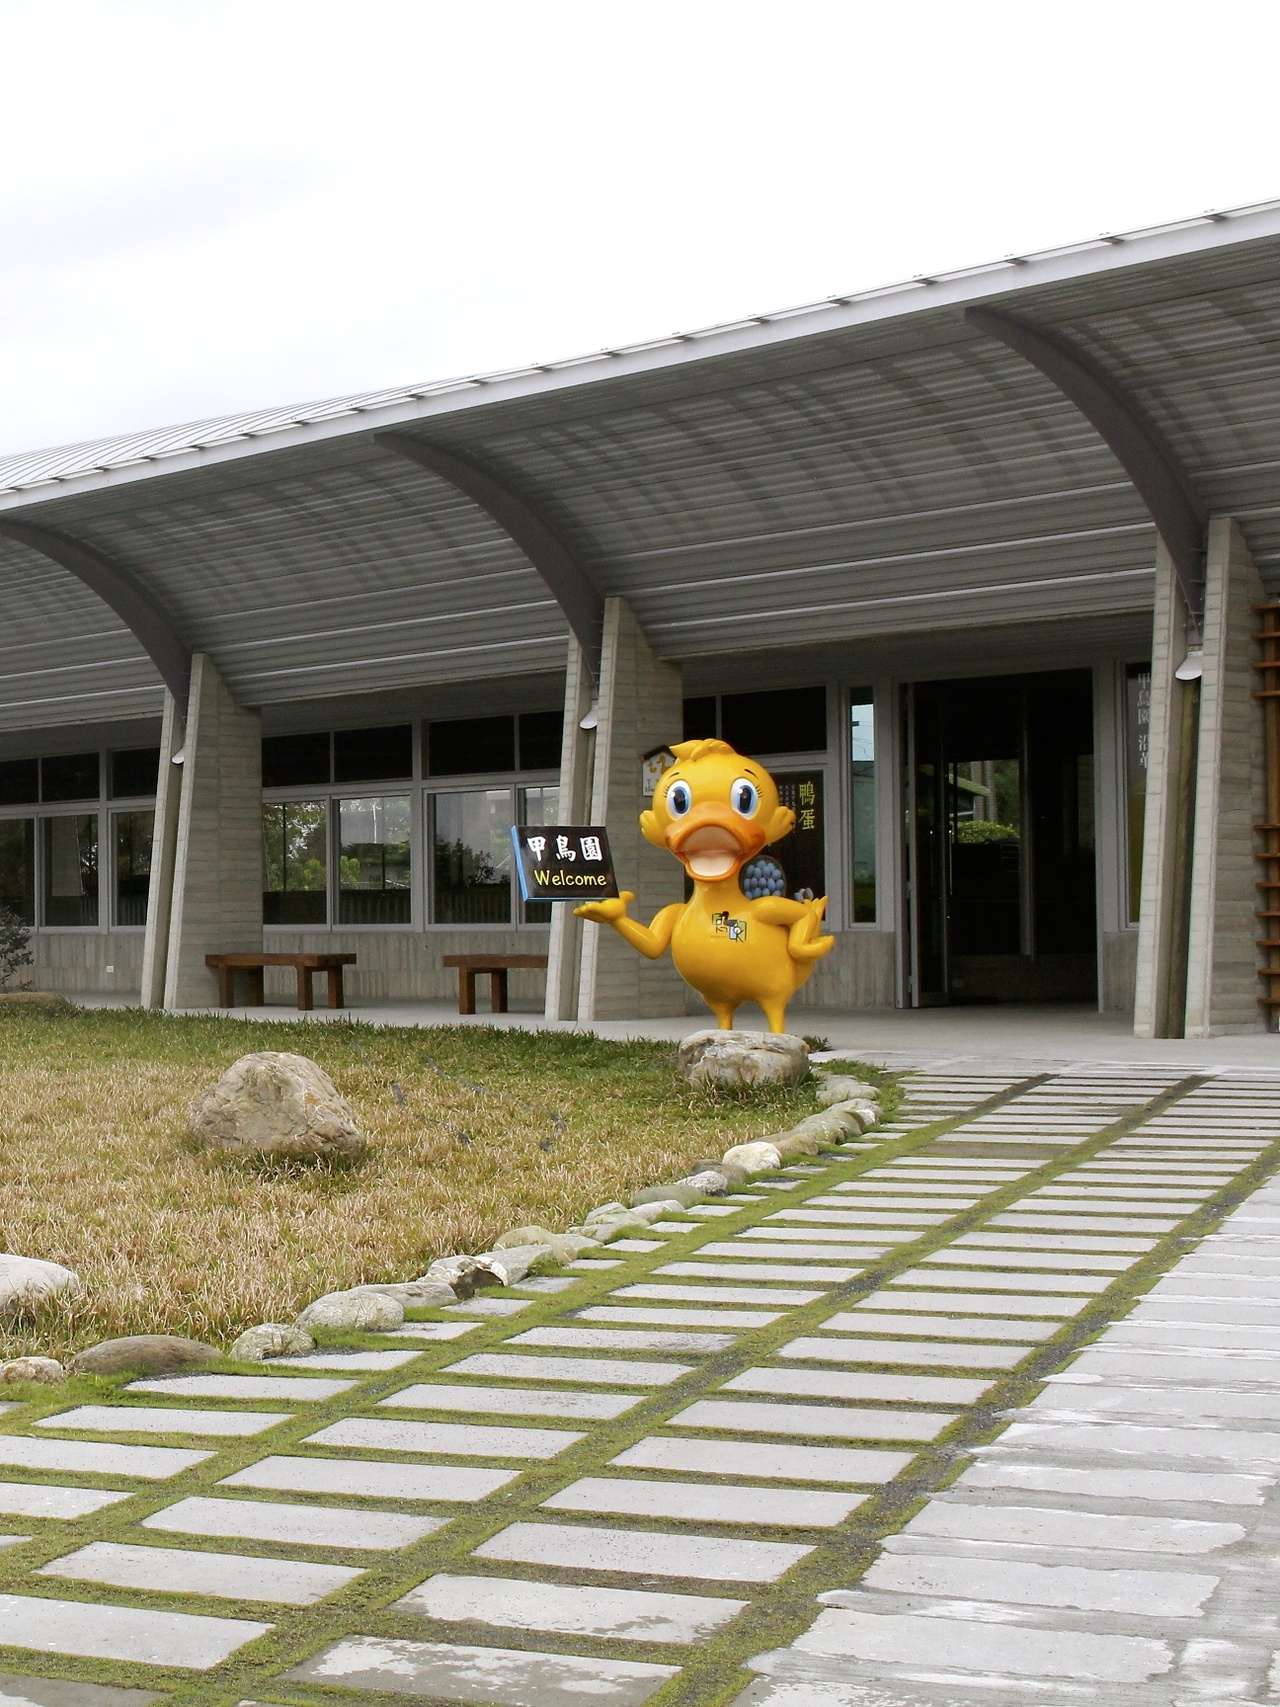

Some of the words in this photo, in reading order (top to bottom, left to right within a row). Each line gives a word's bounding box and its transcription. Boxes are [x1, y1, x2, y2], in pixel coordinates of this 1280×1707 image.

[798, 781, 815, 830] 鴨蛋
[527, 834, 603, 862] 甲鳥園
[534, 869, 607, 886] Welcome
